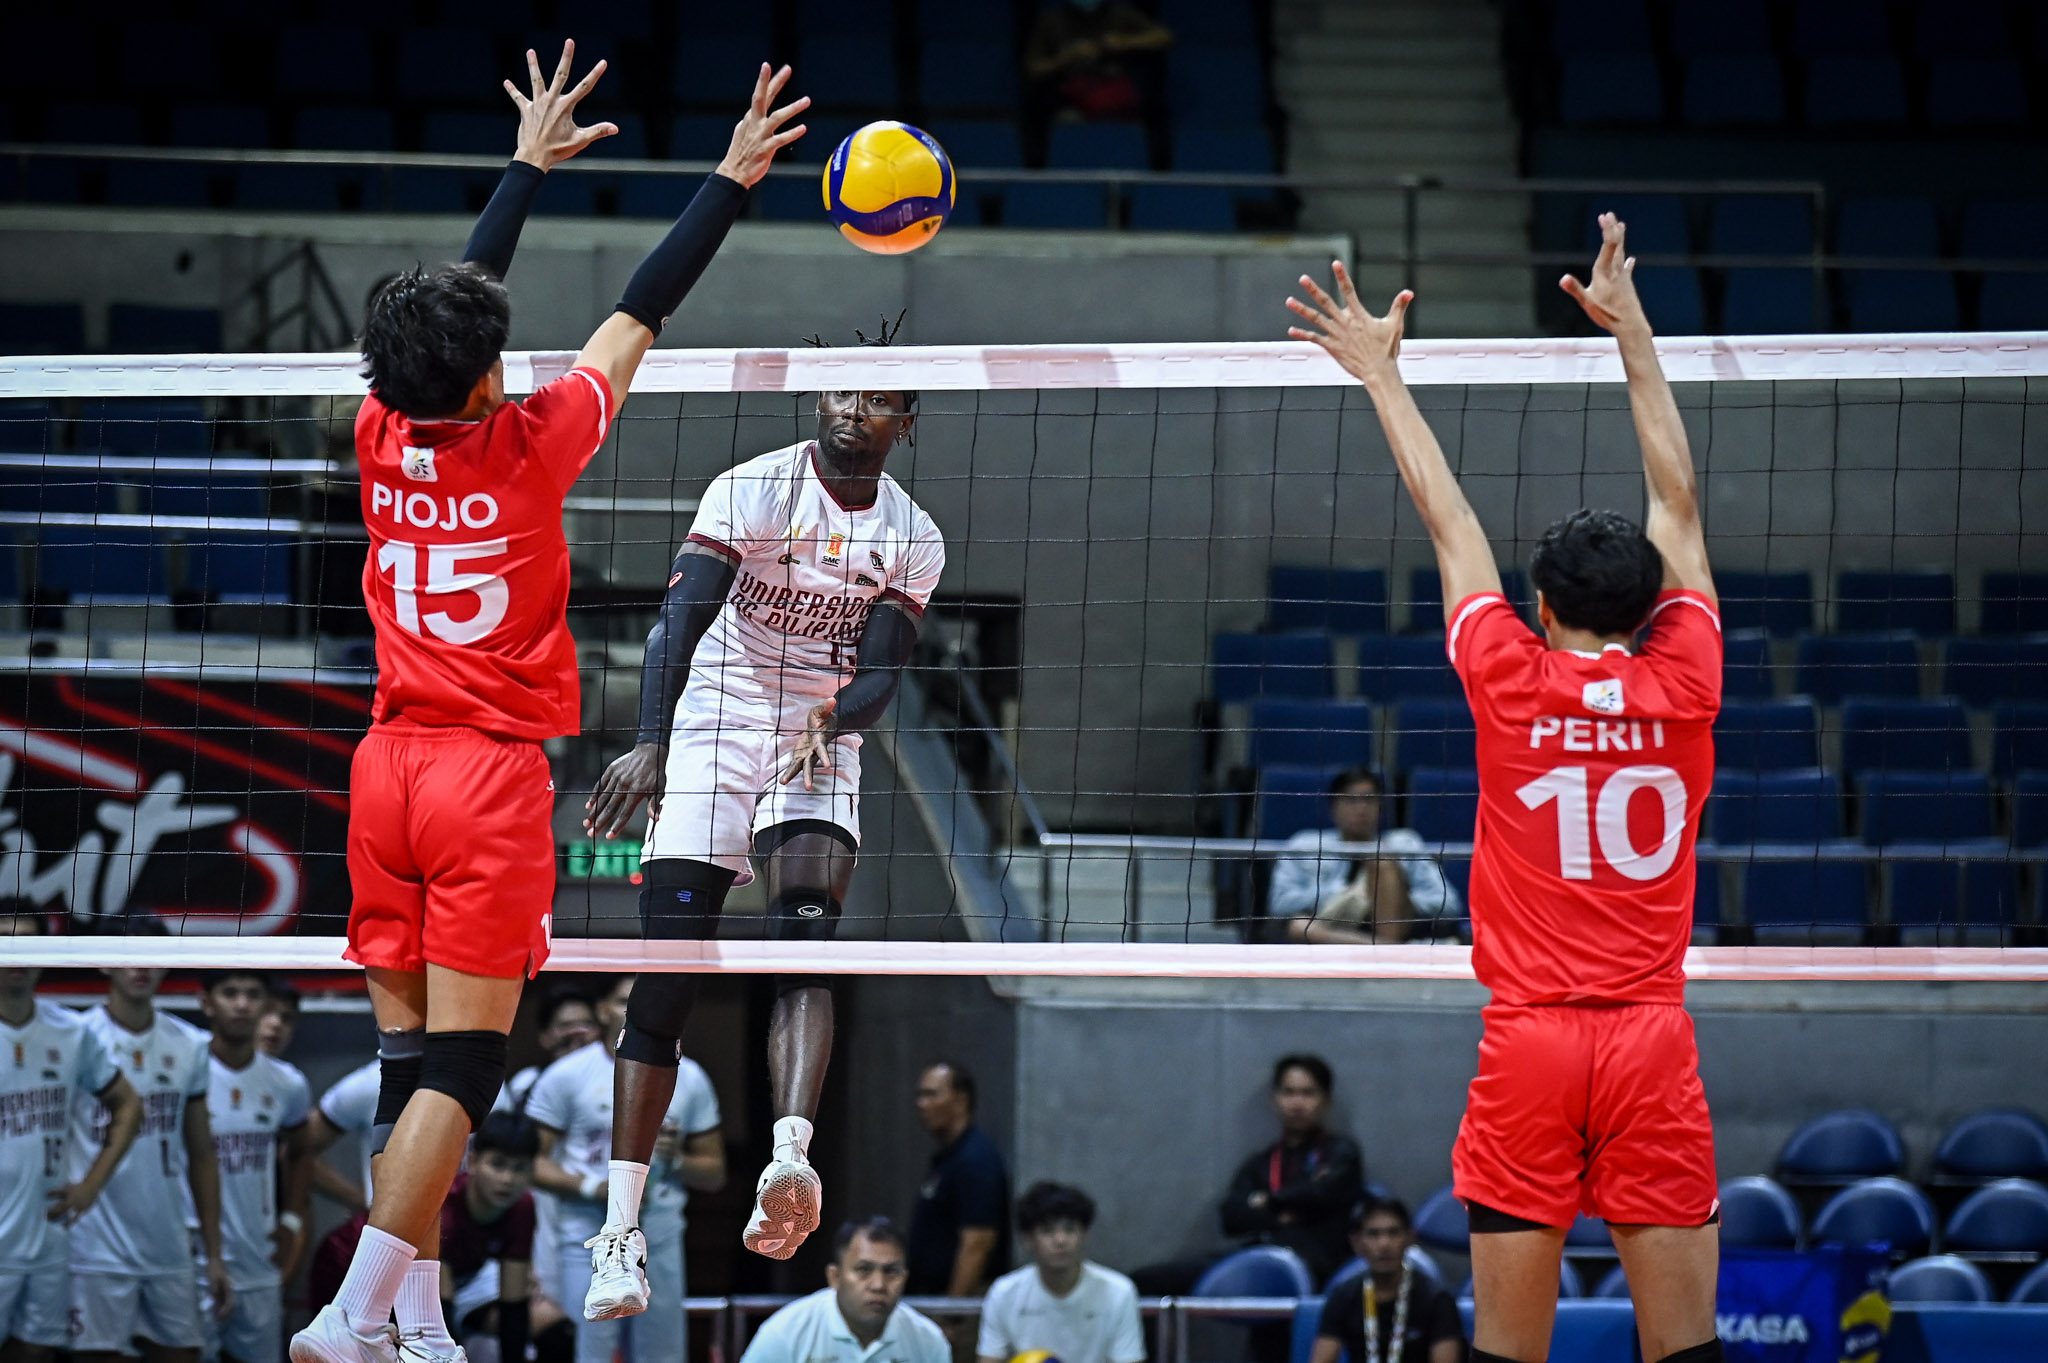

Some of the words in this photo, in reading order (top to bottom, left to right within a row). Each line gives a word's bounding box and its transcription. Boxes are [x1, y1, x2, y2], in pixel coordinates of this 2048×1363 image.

[372, 482, 499, 532] PIOJO
[378, 536, 510, 645] 15
[822, 555, 841, 565] SMC
[1514, 764, 1689, 881] 10
